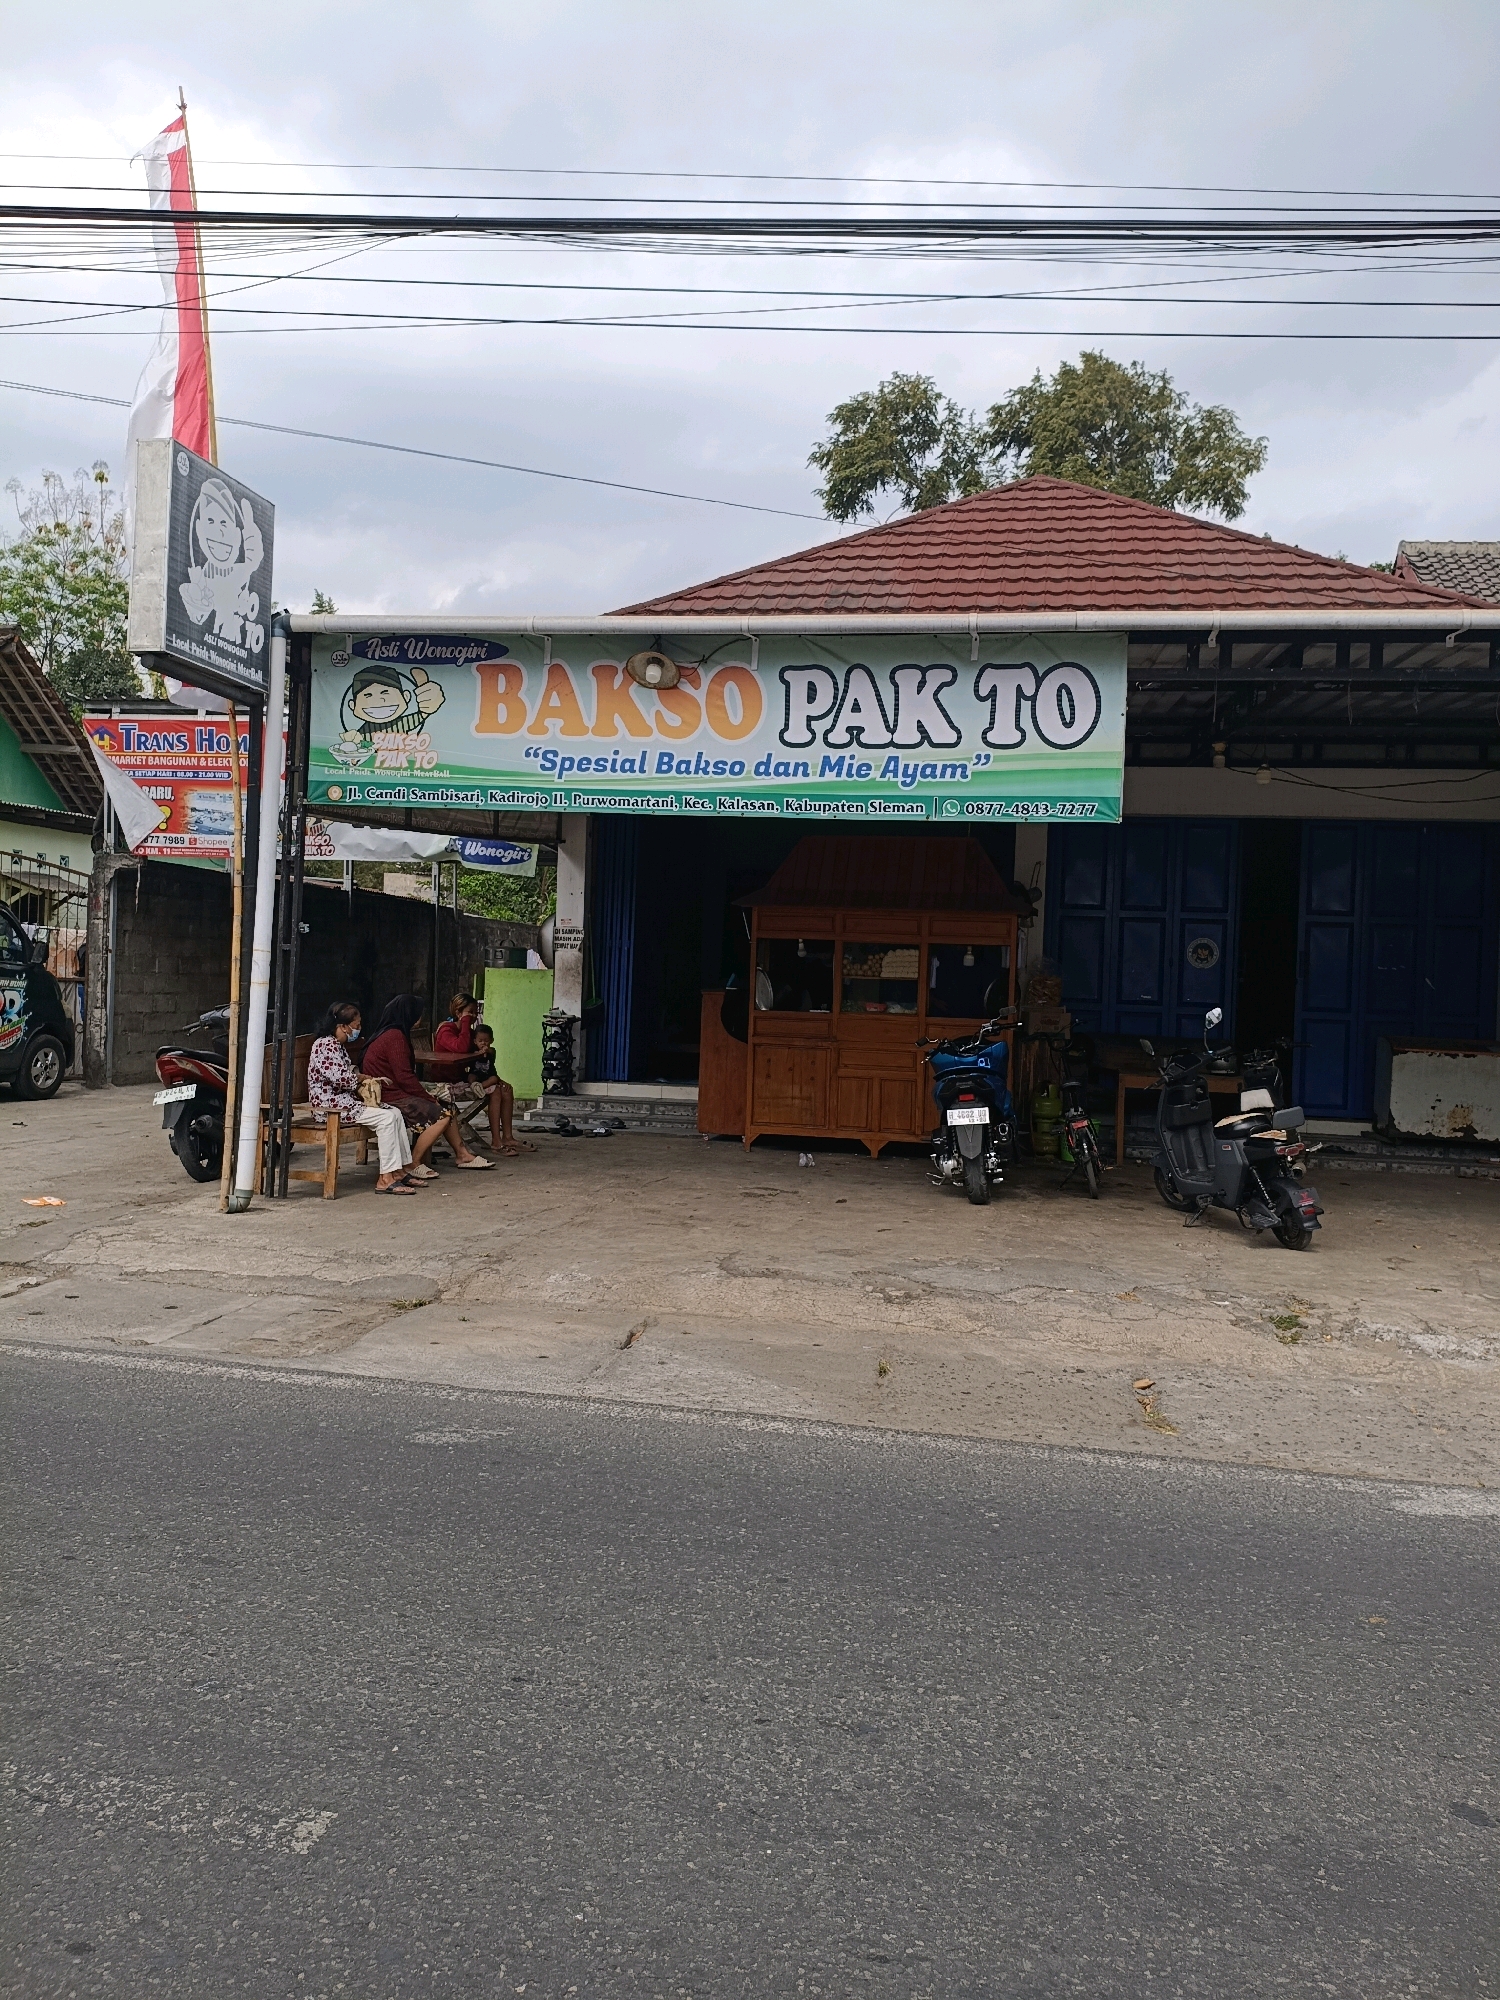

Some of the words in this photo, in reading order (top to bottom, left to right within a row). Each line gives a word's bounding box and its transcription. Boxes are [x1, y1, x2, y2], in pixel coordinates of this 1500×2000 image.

[364, 637, 400, 659] Asli
[403, 637, 488, 666] Wonogiri
[474, 662, 764, 740] BAKSO
[778, 663, 963, 750] PAK
[973, 661, 1102, 750] TO
[195, 727, 250, 753] HOM
[372, 731, 431, 751] BAKSO
[109, 755, 147, 765] MARKET
[147, 756, 198, 767] BANGUNAN
[200, 757, 207, 767] &
[374, 749, 412, 769] PAK
[413, 749, 439, 770] TO
[655, 751, 746, 777] Bakso
[753, 752, 810, 780] dan
[819, 752, 873, 781] Mie
[347, 787, 361, 801] Jl.
[366, 787, 406, 800] Candi
[410, 788, 485, 804] Sambisari,
[489, 790, 549, 807] Kadirojo
[573, 793, 679, 810] Purwomartani,
[684, 796, 712, 810] Kec.
[717, 797, 780, 813] Kalasan,
[785, 798, 864, 817] Kabupaten
[868, 799, 924, 815] Sleman
[964, 801, 1098, 817] 0877-4843-7277
[145, 847, 161, 855] KM.
[163, 836, 185, 845] 7989
[198, 836, 228, 847] Shopee
[464, 839, 532, 863] Wonogiri
